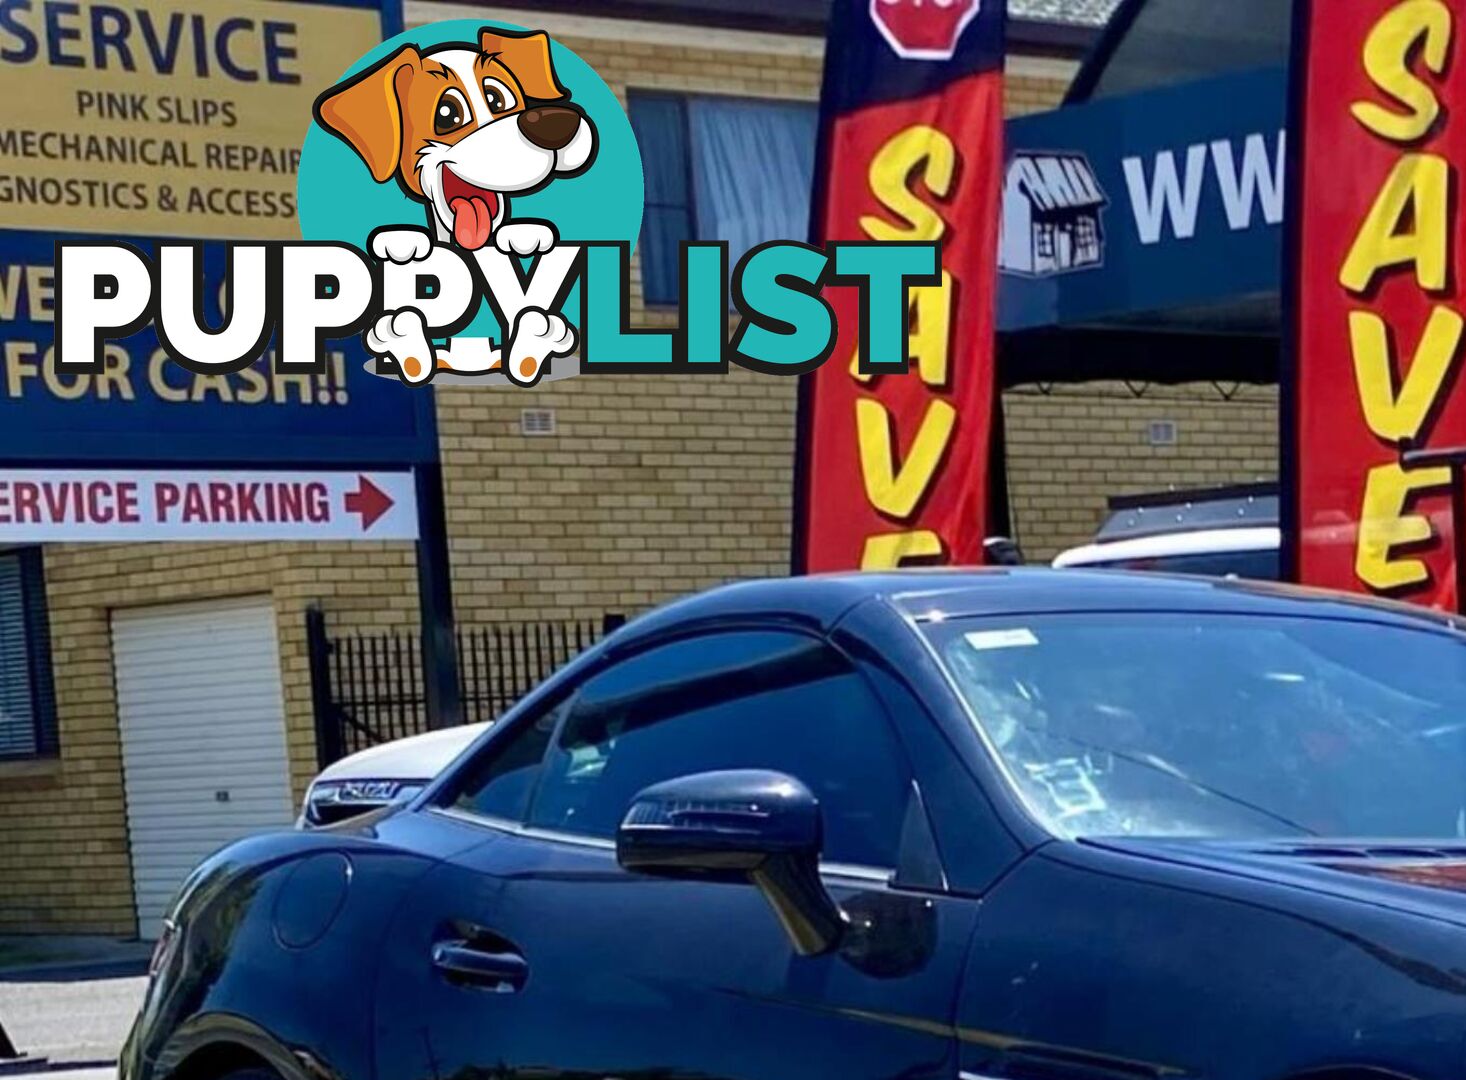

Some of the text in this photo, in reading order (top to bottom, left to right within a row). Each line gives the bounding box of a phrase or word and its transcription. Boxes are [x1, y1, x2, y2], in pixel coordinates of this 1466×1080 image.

[0, 0, 302, 85] SERVICE
[76, 90, 238, 128] PINK SLIPS
[0, 130, 197, 169] MECHANICAL
[158, 185, 178, 213] &
[1338, 0, 1464, 588] SAVE
[155, 482, 331, 525] PARKING
